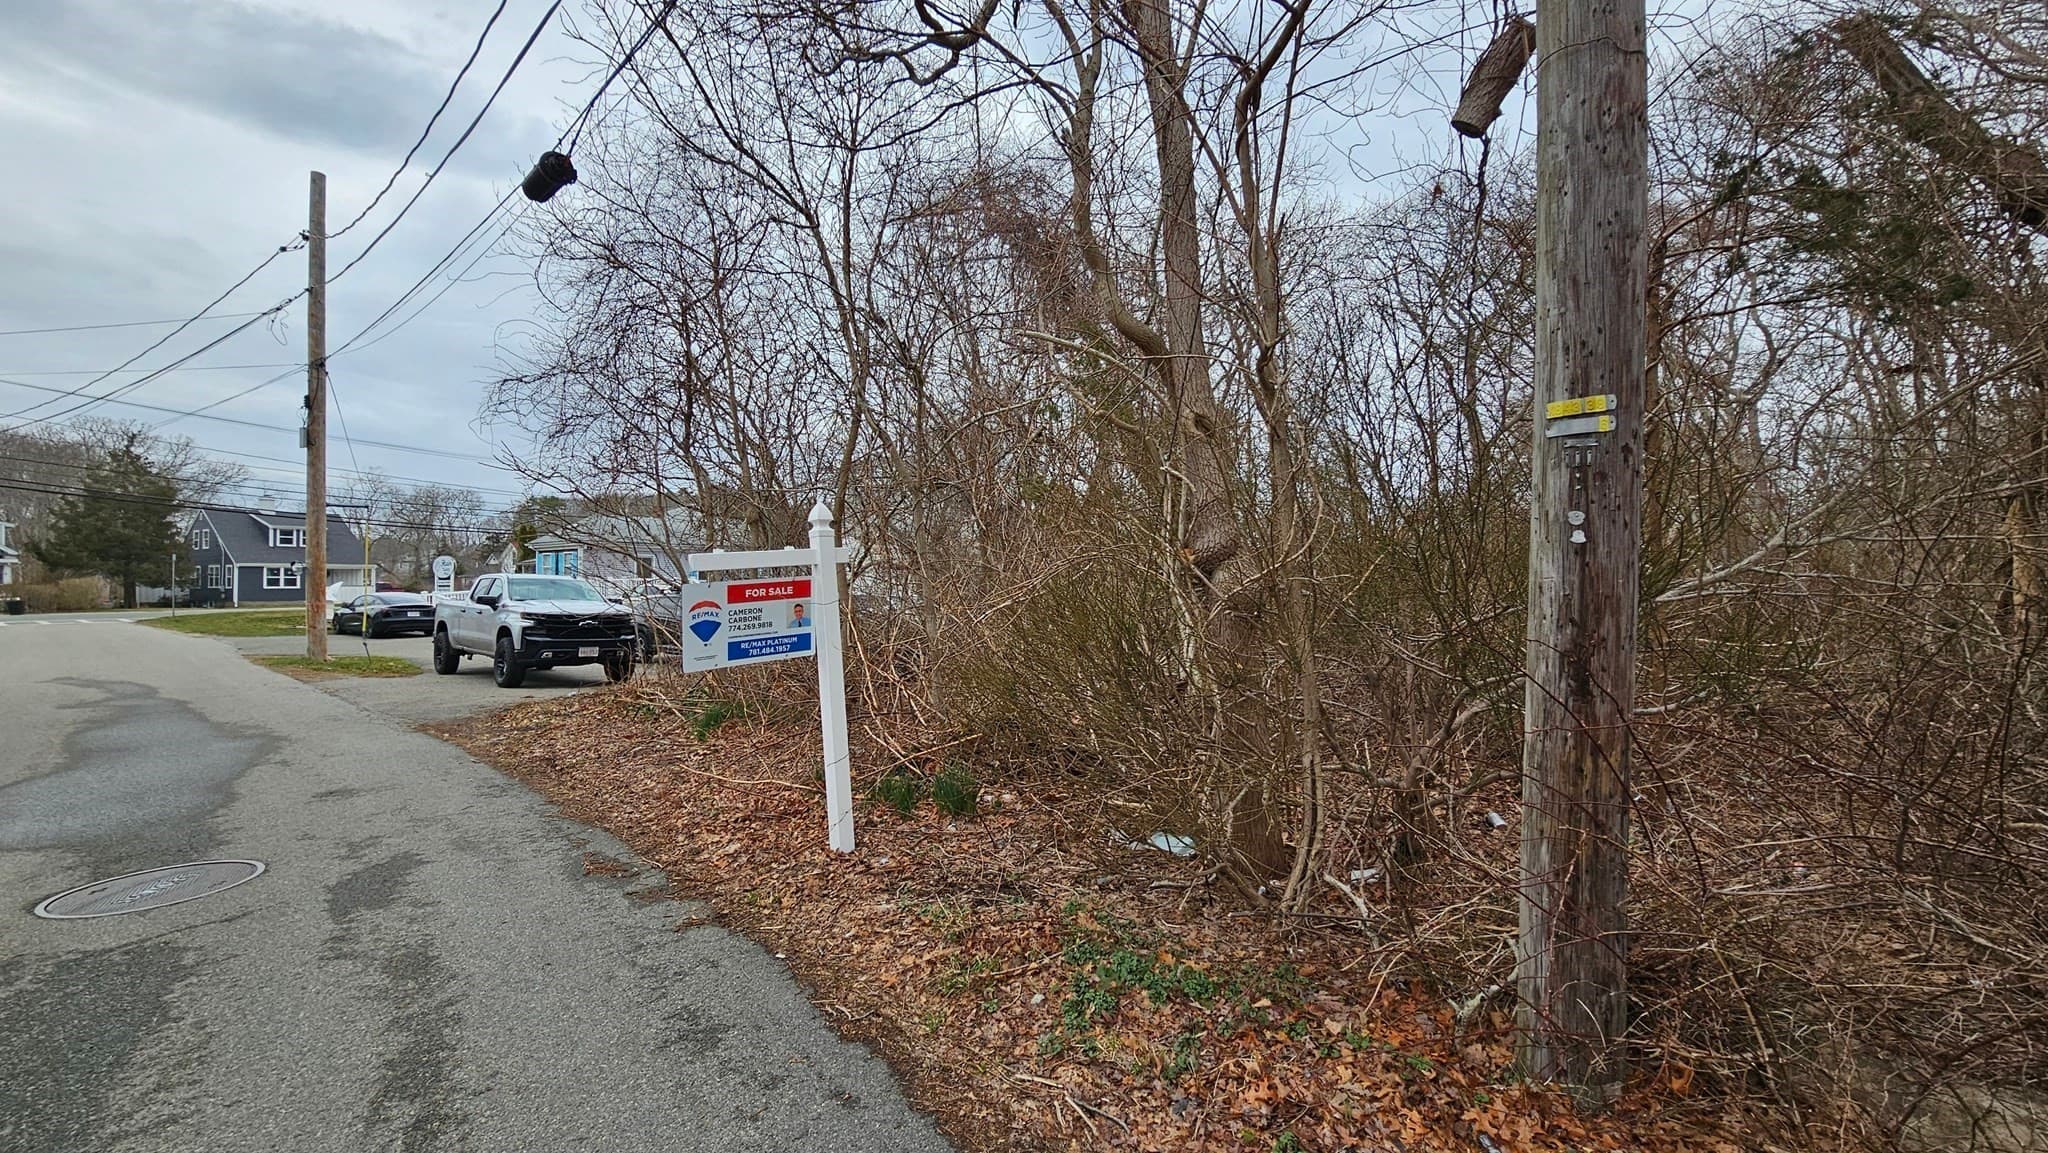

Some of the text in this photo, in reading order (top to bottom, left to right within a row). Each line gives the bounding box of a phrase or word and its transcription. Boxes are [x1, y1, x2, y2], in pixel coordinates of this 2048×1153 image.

[745, 586, 794, 598] FOR SALE
[691, 610, 720, 620] RE/MAX
[728, 607, 763, 617] CAMERON
[728, 615, 762, 624] CARBONE
[728, 621, 773, 632] 774.269.9818
[740, 636, 798, 649] RE/MAX PLATINUM
